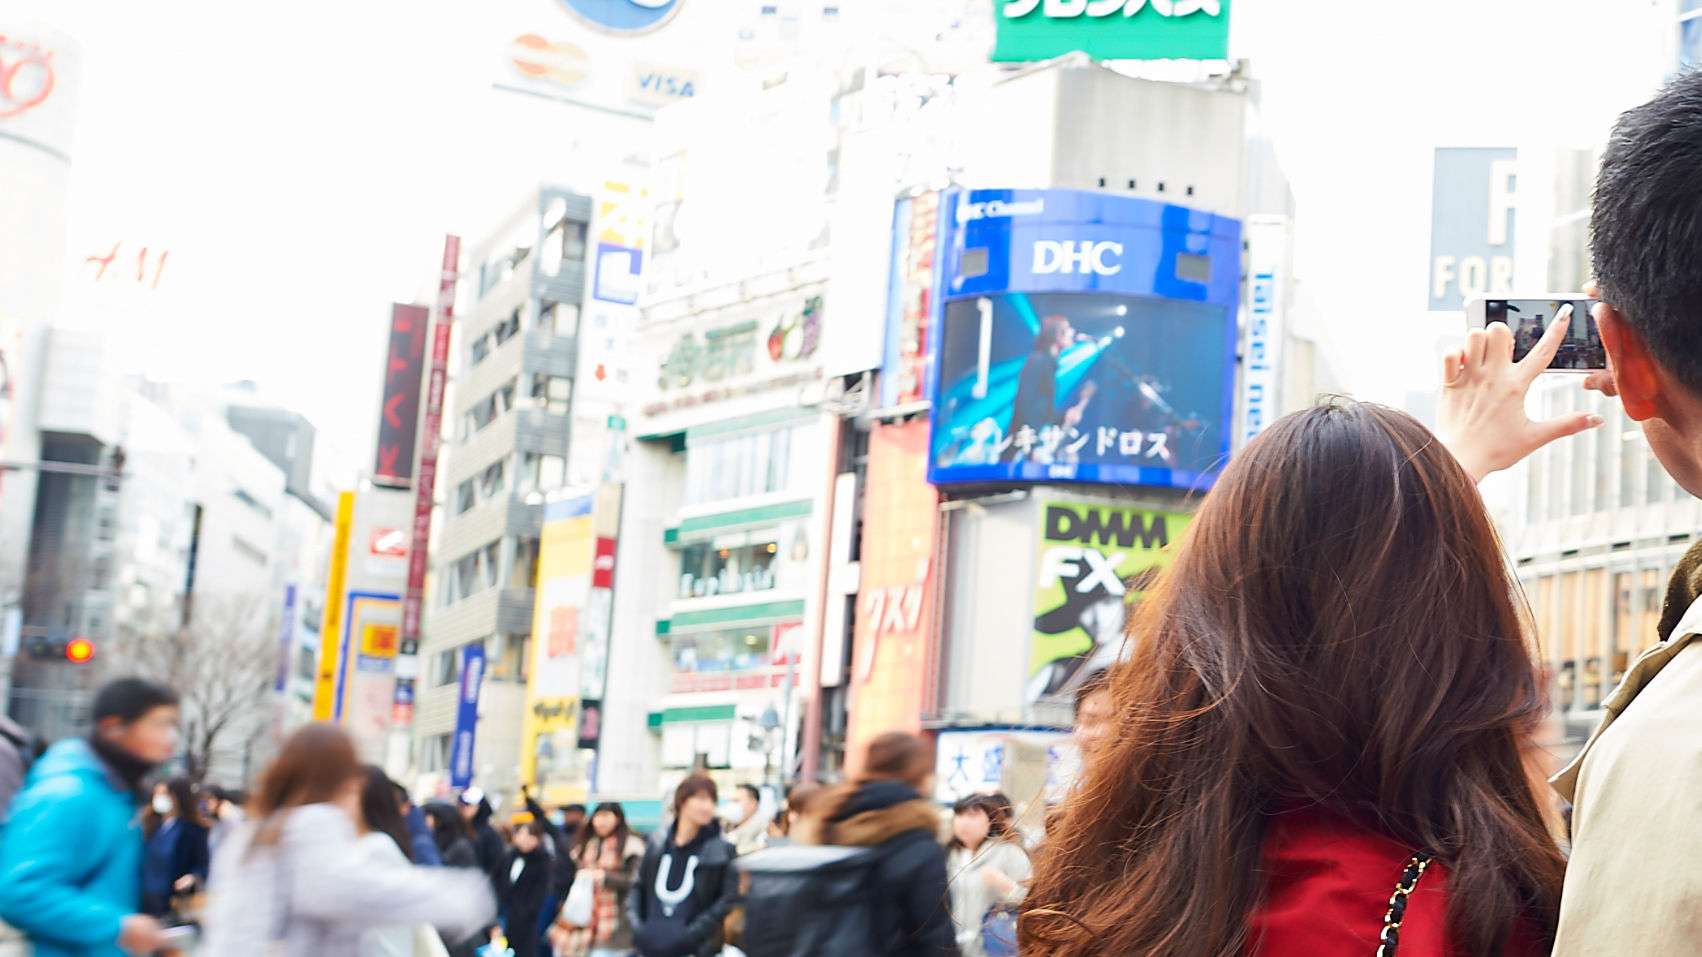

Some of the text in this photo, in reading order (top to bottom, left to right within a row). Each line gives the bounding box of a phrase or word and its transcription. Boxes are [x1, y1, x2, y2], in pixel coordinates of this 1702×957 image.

[638, 74, 695, 97] VISA
[1031, 240, 1124, 275] DHC
[1044, 506, 1167, 548] DMM
[1038, 546, 1128, 596] FX
